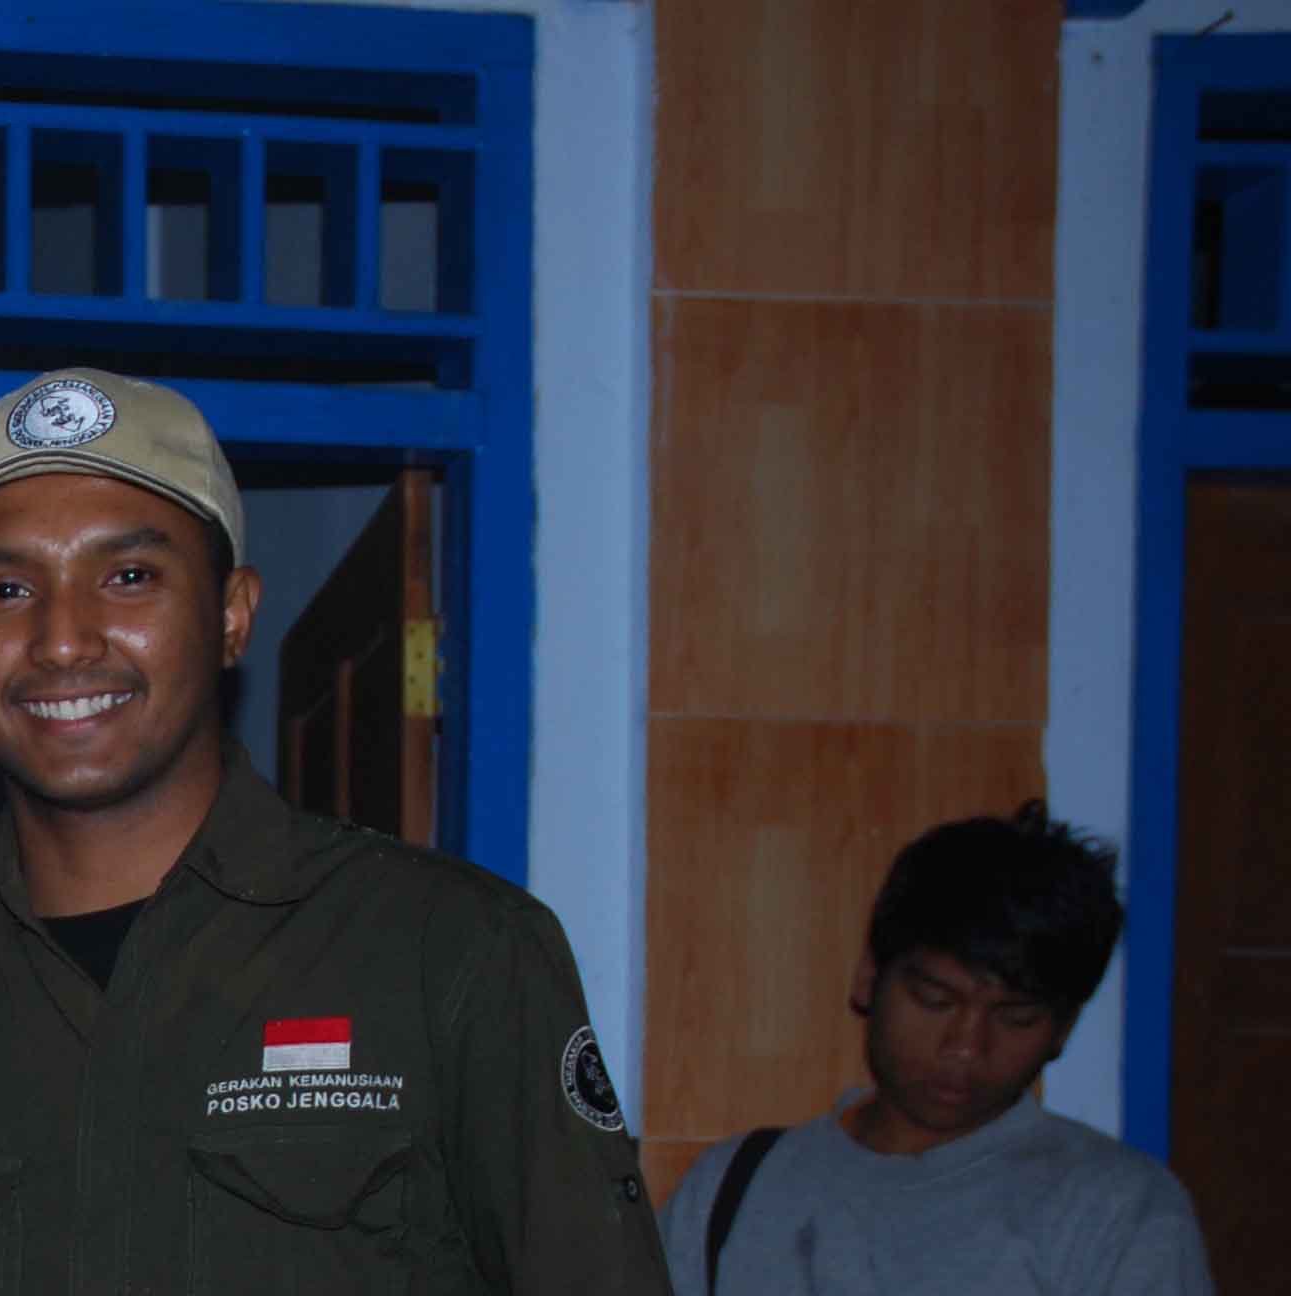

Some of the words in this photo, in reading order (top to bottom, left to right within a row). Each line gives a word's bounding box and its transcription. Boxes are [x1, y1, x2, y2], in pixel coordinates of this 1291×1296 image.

[207, 1075, 283, 1095] GERAKAN
[289, 1073, 404, 1089] KEMANUSIAAN
[206, 1095, 281, 1116] POSKO
[286, 1092, 401, 1110] JENGGALA
